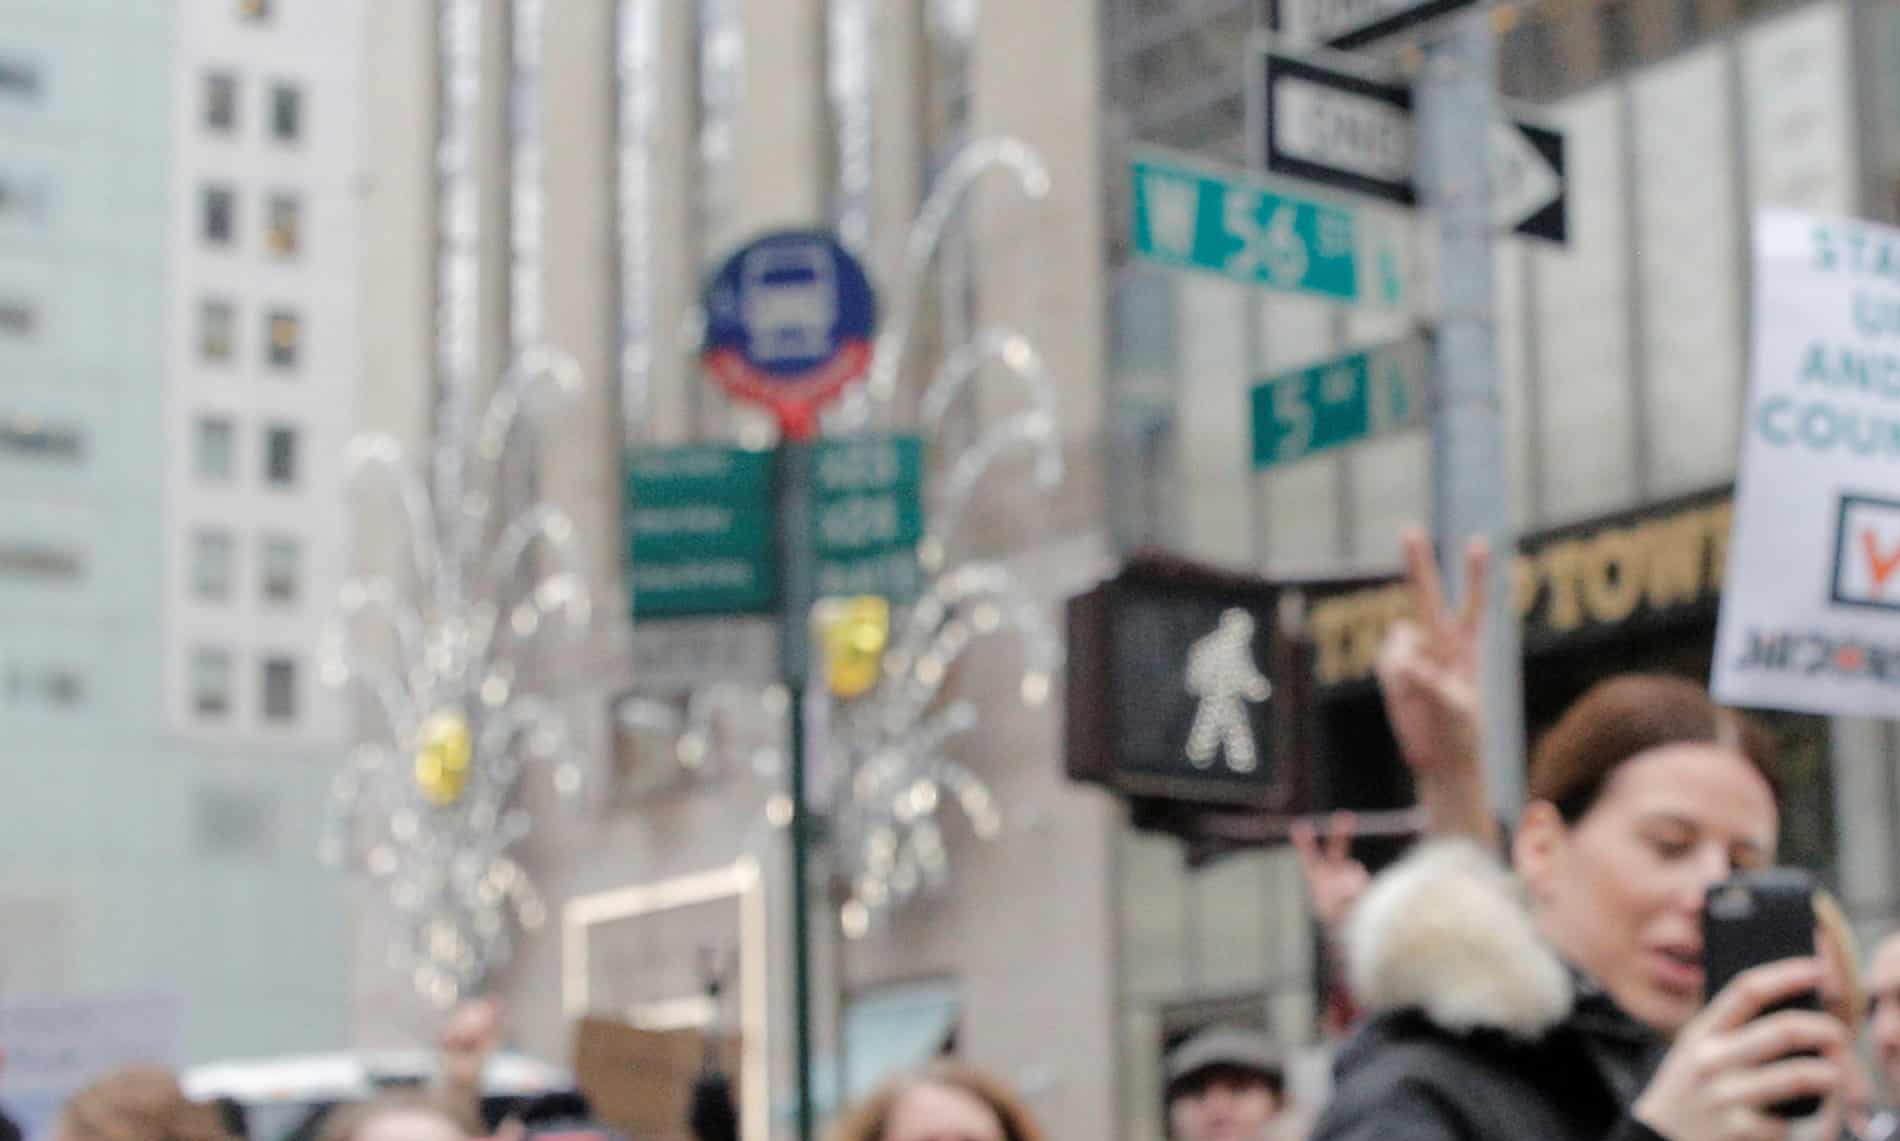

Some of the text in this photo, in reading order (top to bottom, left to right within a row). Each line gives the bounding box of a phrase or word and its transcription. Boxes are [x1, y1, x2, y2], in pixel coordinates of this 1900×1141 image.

[1141, 172, 1199, 260] W
[1221, 181, 1309, 288] 56
[1271, 370, 1316, 461] 5
